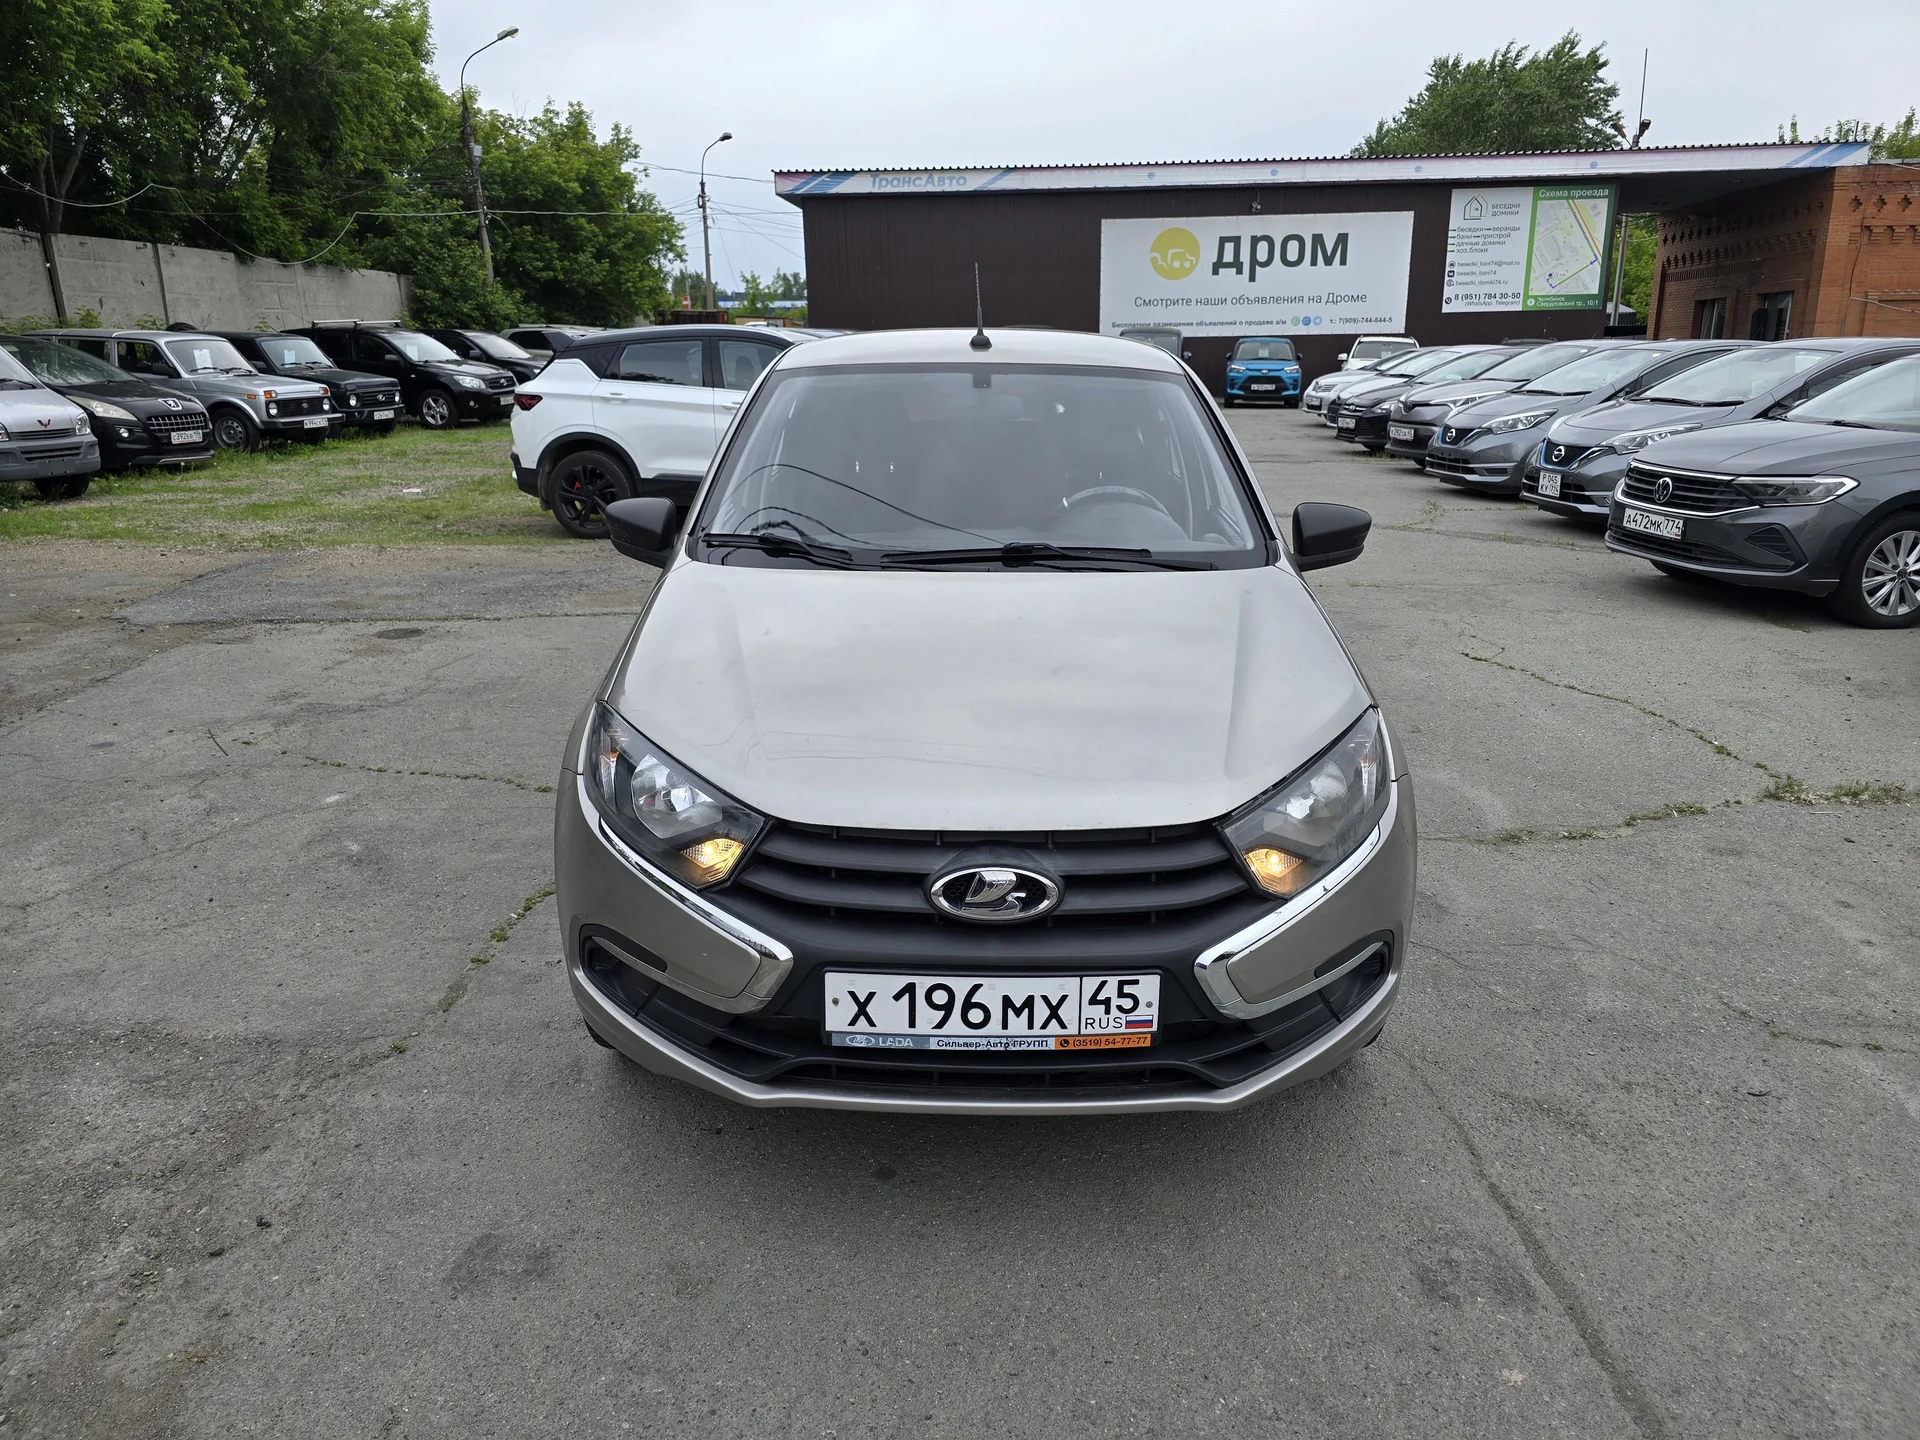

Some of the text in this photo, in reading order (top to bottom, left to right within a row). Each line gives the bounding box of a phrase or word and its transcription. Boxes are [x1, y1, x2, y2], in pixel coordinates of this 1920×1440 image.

[870, 172, 967, 190] ТрансАвто
[1539, 188, 1609, 199] Схема проезда
[1456, 226, 1483, 234] беседки
[1480, 232, 1511, 240] пристрой
[1211, 232, 1350, 283] дром
[1134, 292, 1367, 309] Смотрите наши объявления на Дроме
[1454, 292, 1521, 301] 8 (951) 784 30-50
[1195, 319, 1237, 327] объявлений
[1244, 319, 1273, 327] продаже
[1625, 511, 1682, 533] А472МК 774
[1088, 979, 1140, 1015] 45
[1084, 1016, 1123, 1030] RUS
[878, 1037, 913, 1047] LADA
[1073, 1036, 1147, 1048] (3519) 54-77-77
